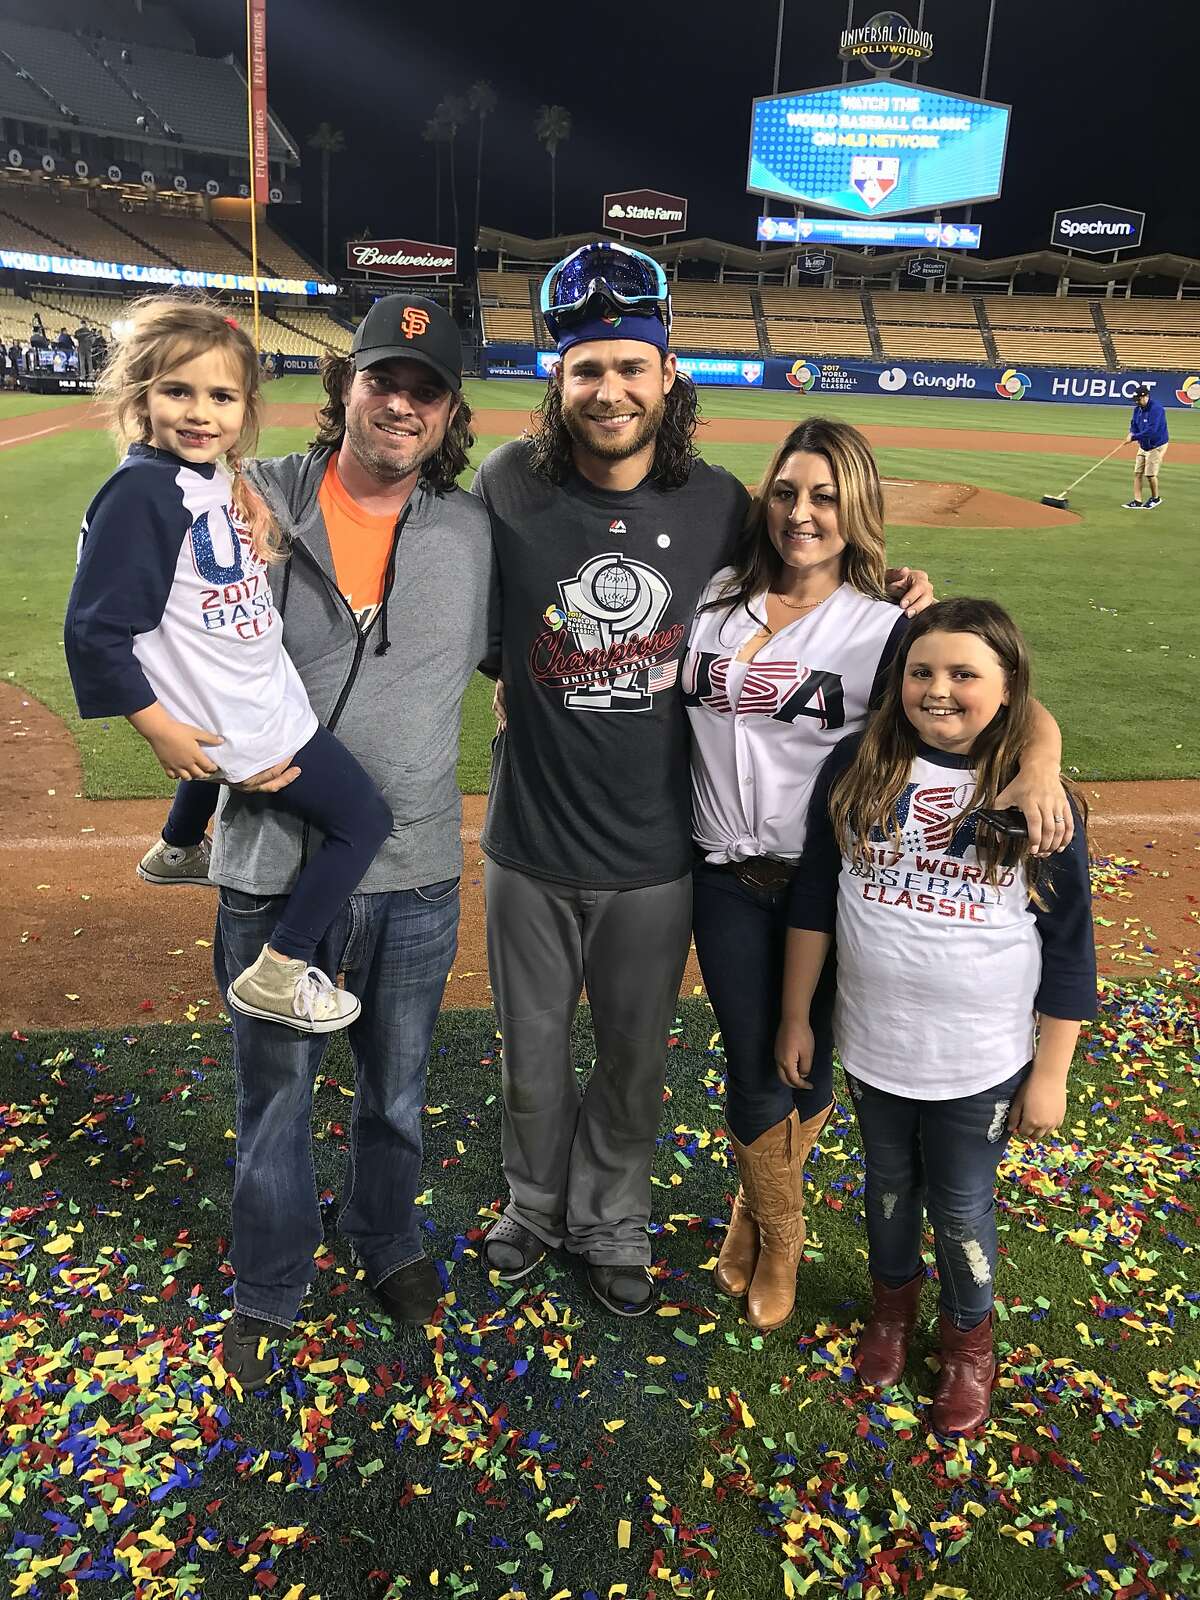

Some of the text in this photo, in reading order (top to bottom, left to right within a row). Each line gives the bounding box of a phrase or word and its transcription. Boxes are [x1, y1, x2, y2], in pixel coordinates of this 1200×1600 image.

[841, 25, 934, 50] UNIVERSAL STUDIOS
[253, 13, 265, 83] Fly Emirates
[852, 45, 921, 57] HOLLYWOOD
[892, 97, 920, 112] THE
[787, 113, 971, 131] WORLD BASEBALL CLASSIC
[255, 109, 266, 178] Fly Emirates
[812, 132, 940, 149] ON MLB NETWORK
[1059, 219, 1131, 238] Spectrum
[352, 246, 454, 267] Budweiser
[1, 250, 49, 272] WORLD
[52, 256, 121, 280] BASEBALL
[122, 264, 181, 285] CLASSIC
[181, 270, 204, 287] ON
[699, 362, 737, 371] CLASSIC
[821, 370, 848, 378] WORLD
[820, 382, 852, 390] CLASSIC
[912, 371, 976, 391] GungHo
[200, 575, 259, 609] 2017
[567, 626, 595, 636] CLASSIC
[530, 624, 686, 685] Champions
[561, 656, 657, 685] UNITED STATES
[915, 855, 1015, 888] WORLD
[862, 882, 986, 922] CLASSIC
